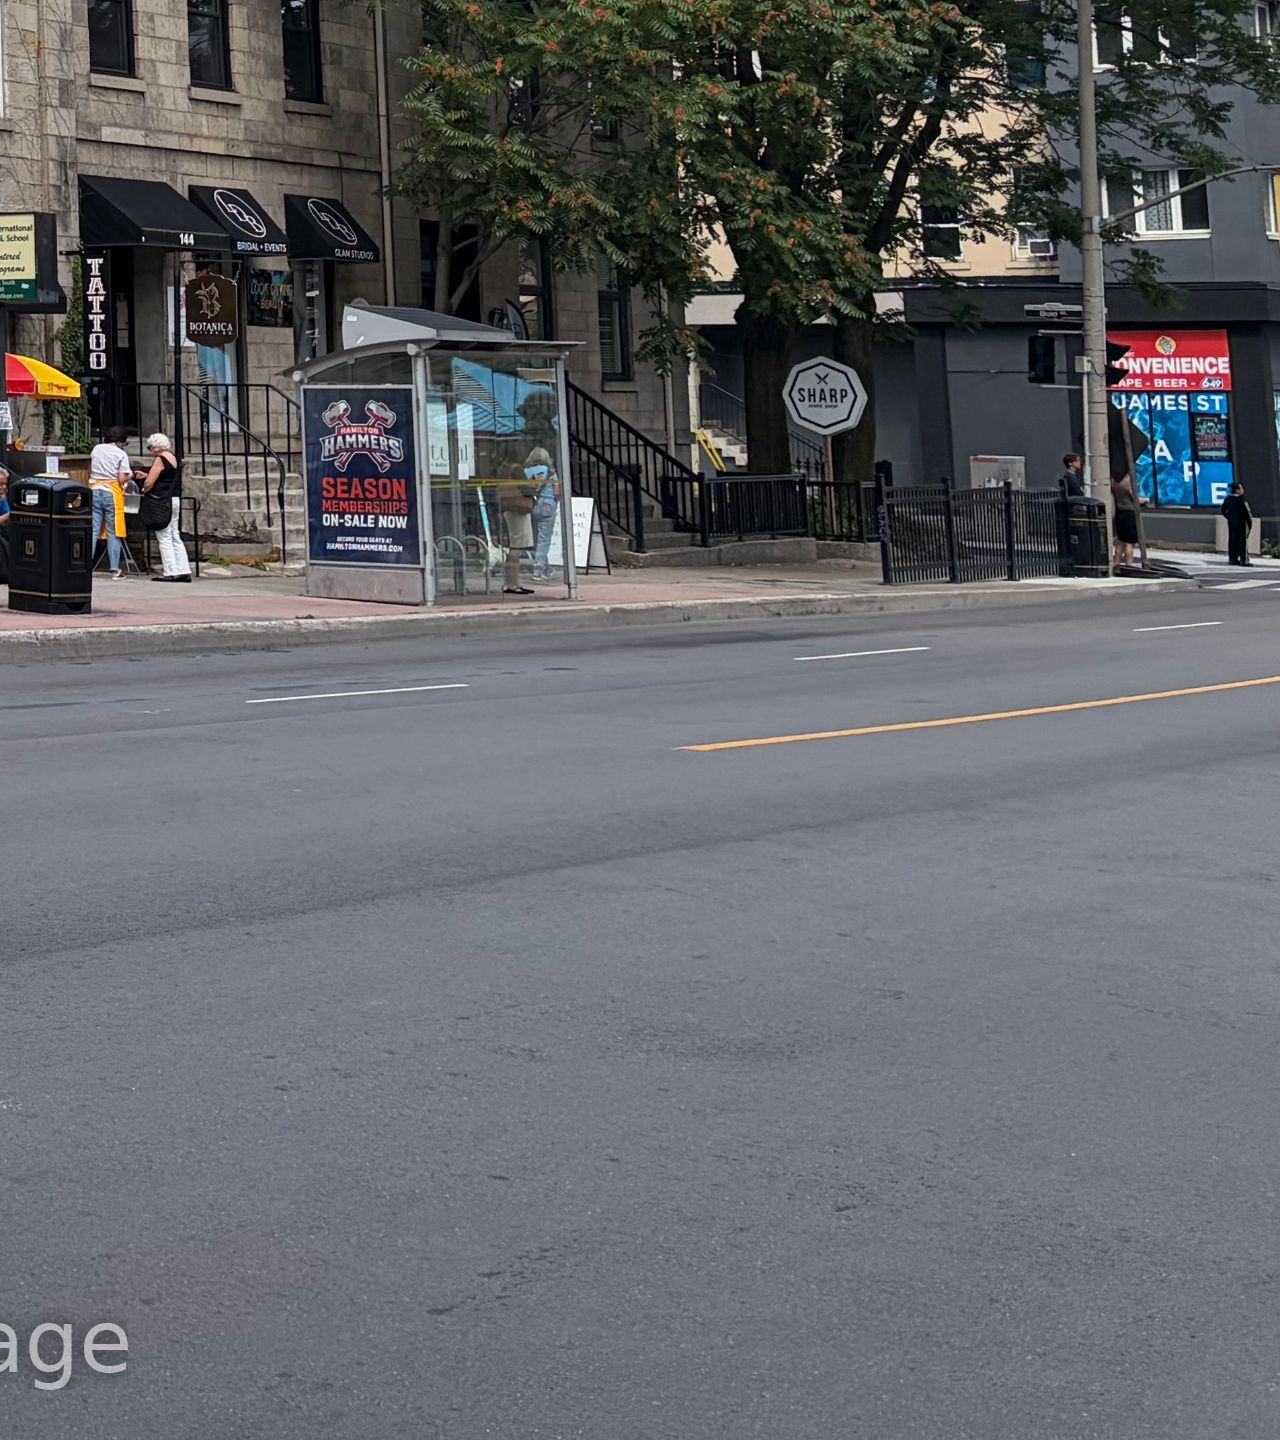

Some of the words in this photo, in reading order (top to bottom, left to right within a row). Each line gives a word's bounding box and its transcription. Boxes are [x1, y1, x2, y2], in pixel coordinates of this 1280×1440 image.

[6, 234, 29, 242] School
[179, 233, 194, 246] 144
[237, 241, 259, 252] BRIDAL
[264, 243, 287, 253] EVENTS
[86, 258, 107, 370] TATTOO
[190, 322, 233, 332] BOTANICA
[1112, 357, 1230, 375] ONVENIENCE
[1114, 378, 1143, 388] APE
[1154, 378, 1188, 388] BEER
[797, 387, 848, 403] SHARP
[1112, 395, 1188, 410] JAMES
[1197, 395, 1224, 410] ST
[340, 426, 379, 434] HAMILTON
[323, 434, 401, 459] HAMMERS
[322, 477, 408, 500] SEASON
[322, 500, 408, 513] MEMBERSHIPS
[322, 513, 375, 528] ON-SALE
[378, 515, 408, 529] NOW
[326, 543, 403, 553] HAMILTONHAMMERS.COM
